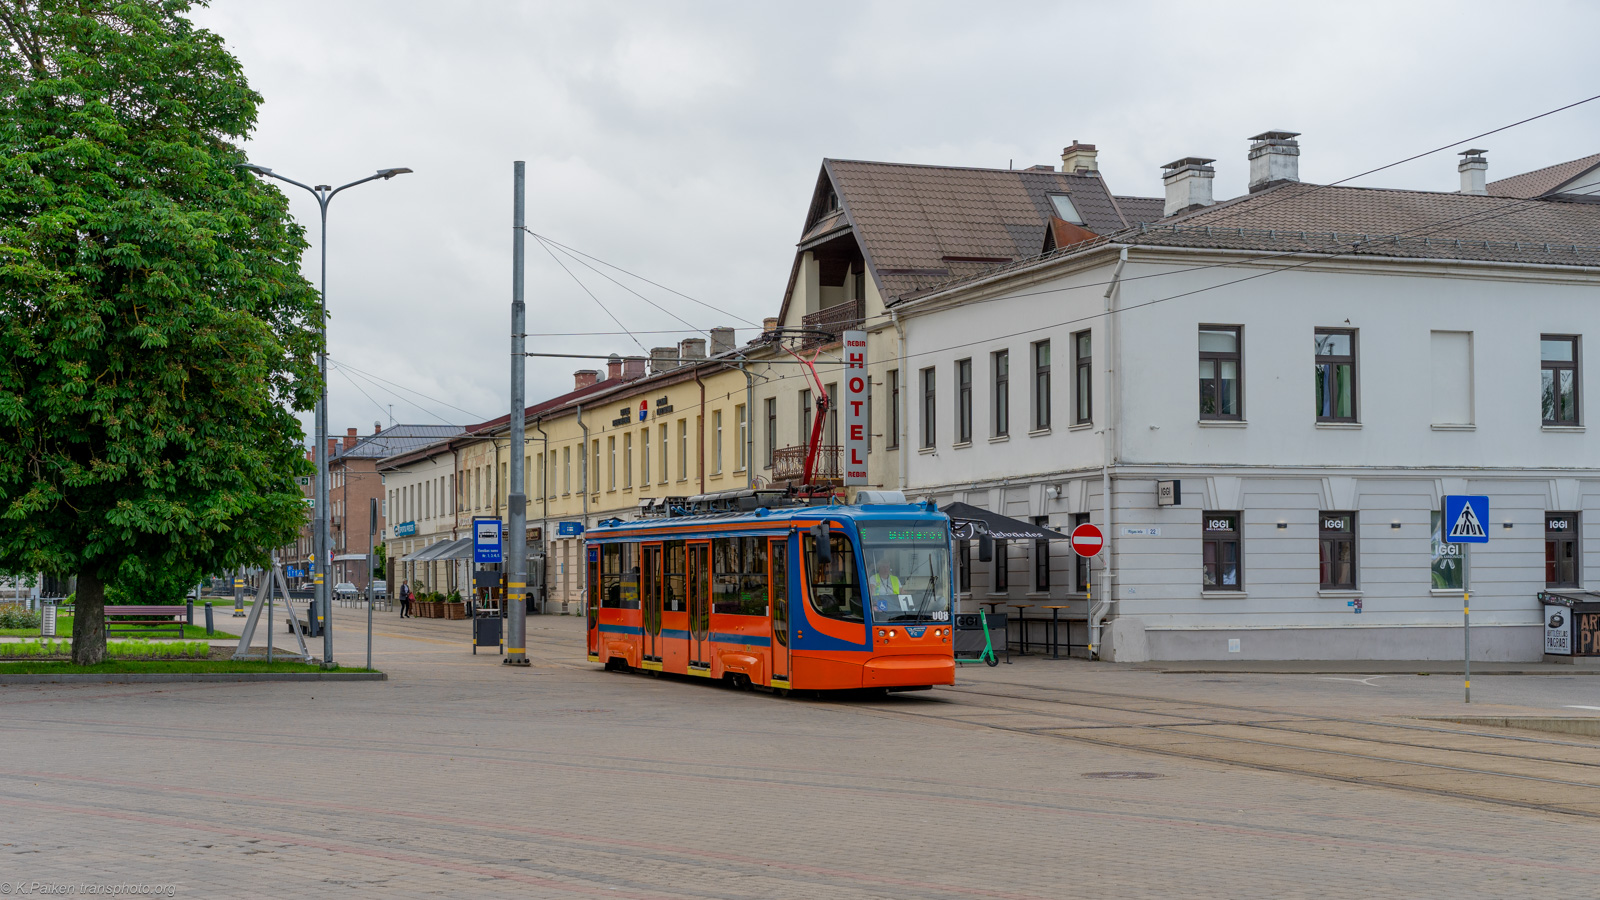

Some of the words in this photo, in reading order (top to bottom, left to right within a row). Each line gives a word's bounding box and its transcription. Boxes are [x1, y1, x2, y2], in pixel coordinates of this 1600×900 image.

[847, 340, 866, 348] REBIR
[849, 353, 864, 464] HOTEL
[1161, 486, 1170, 496] IGGI
[1209, 519, 1229, 529] IGGI
[1324, 519, 1344, 529] IGGI
[1549, 520, 1568, 529] IGGI
[860, 528, 867, 540] 1
[1435, 544, 1459, 555] IGGI
[956, 616, 978, 627] GGI
[1546, 637, 1569, 649] PAGRABI
